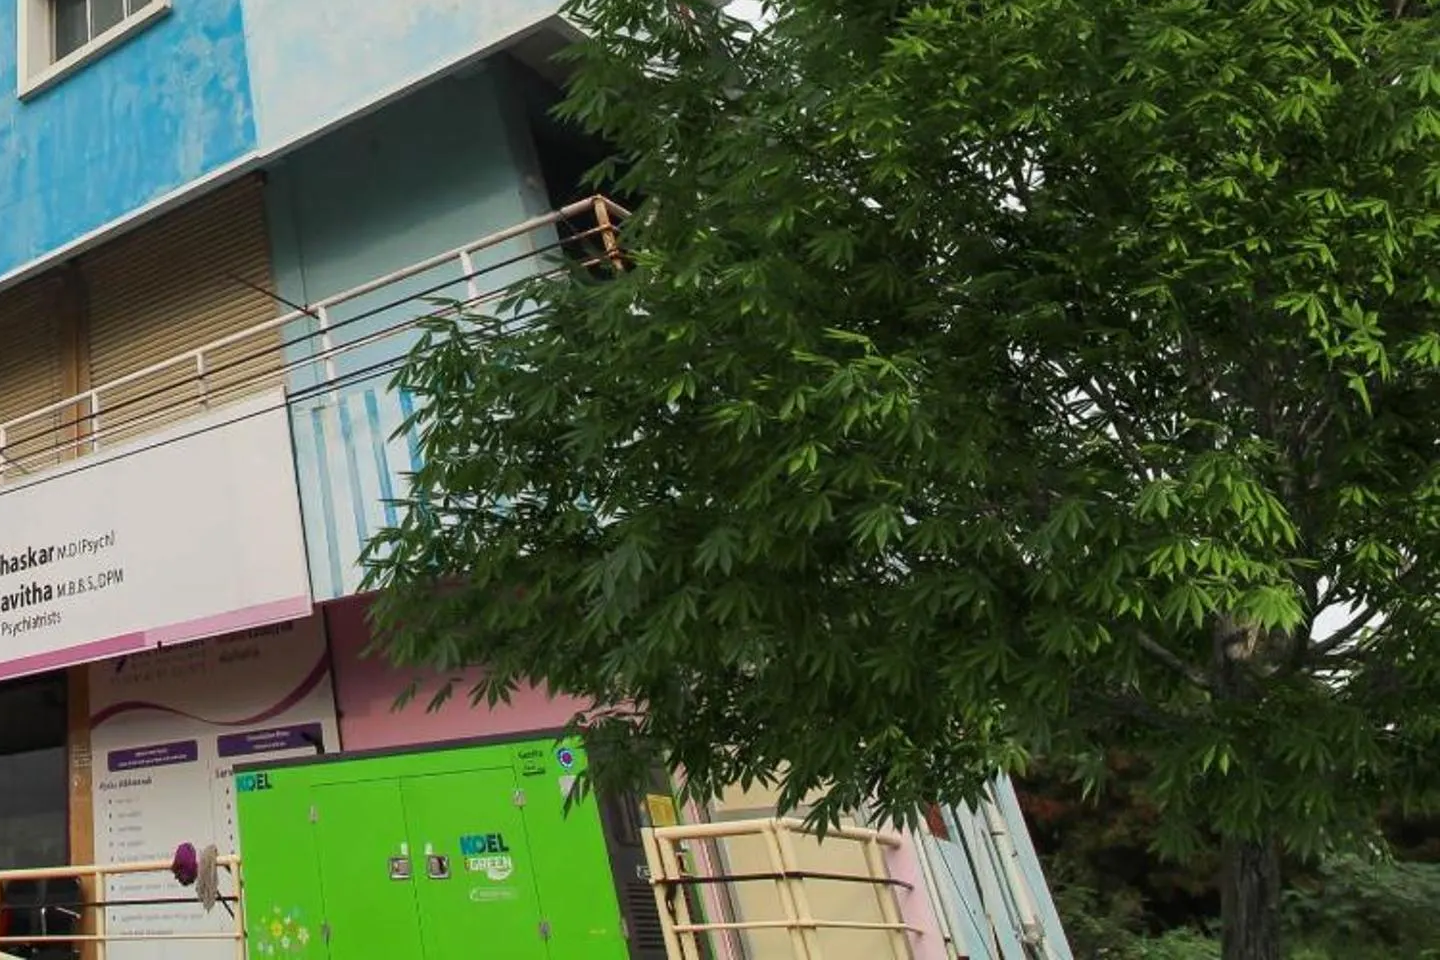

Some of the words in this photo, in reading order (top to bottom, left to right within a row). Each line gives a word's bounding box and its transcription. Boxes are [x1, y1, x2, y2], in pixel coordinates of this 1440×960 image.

[1, 611, 62, 638] Psychiatrists
[237, 772, 273, 793] KOEL
[460, 832, 510, 856] KOEL
